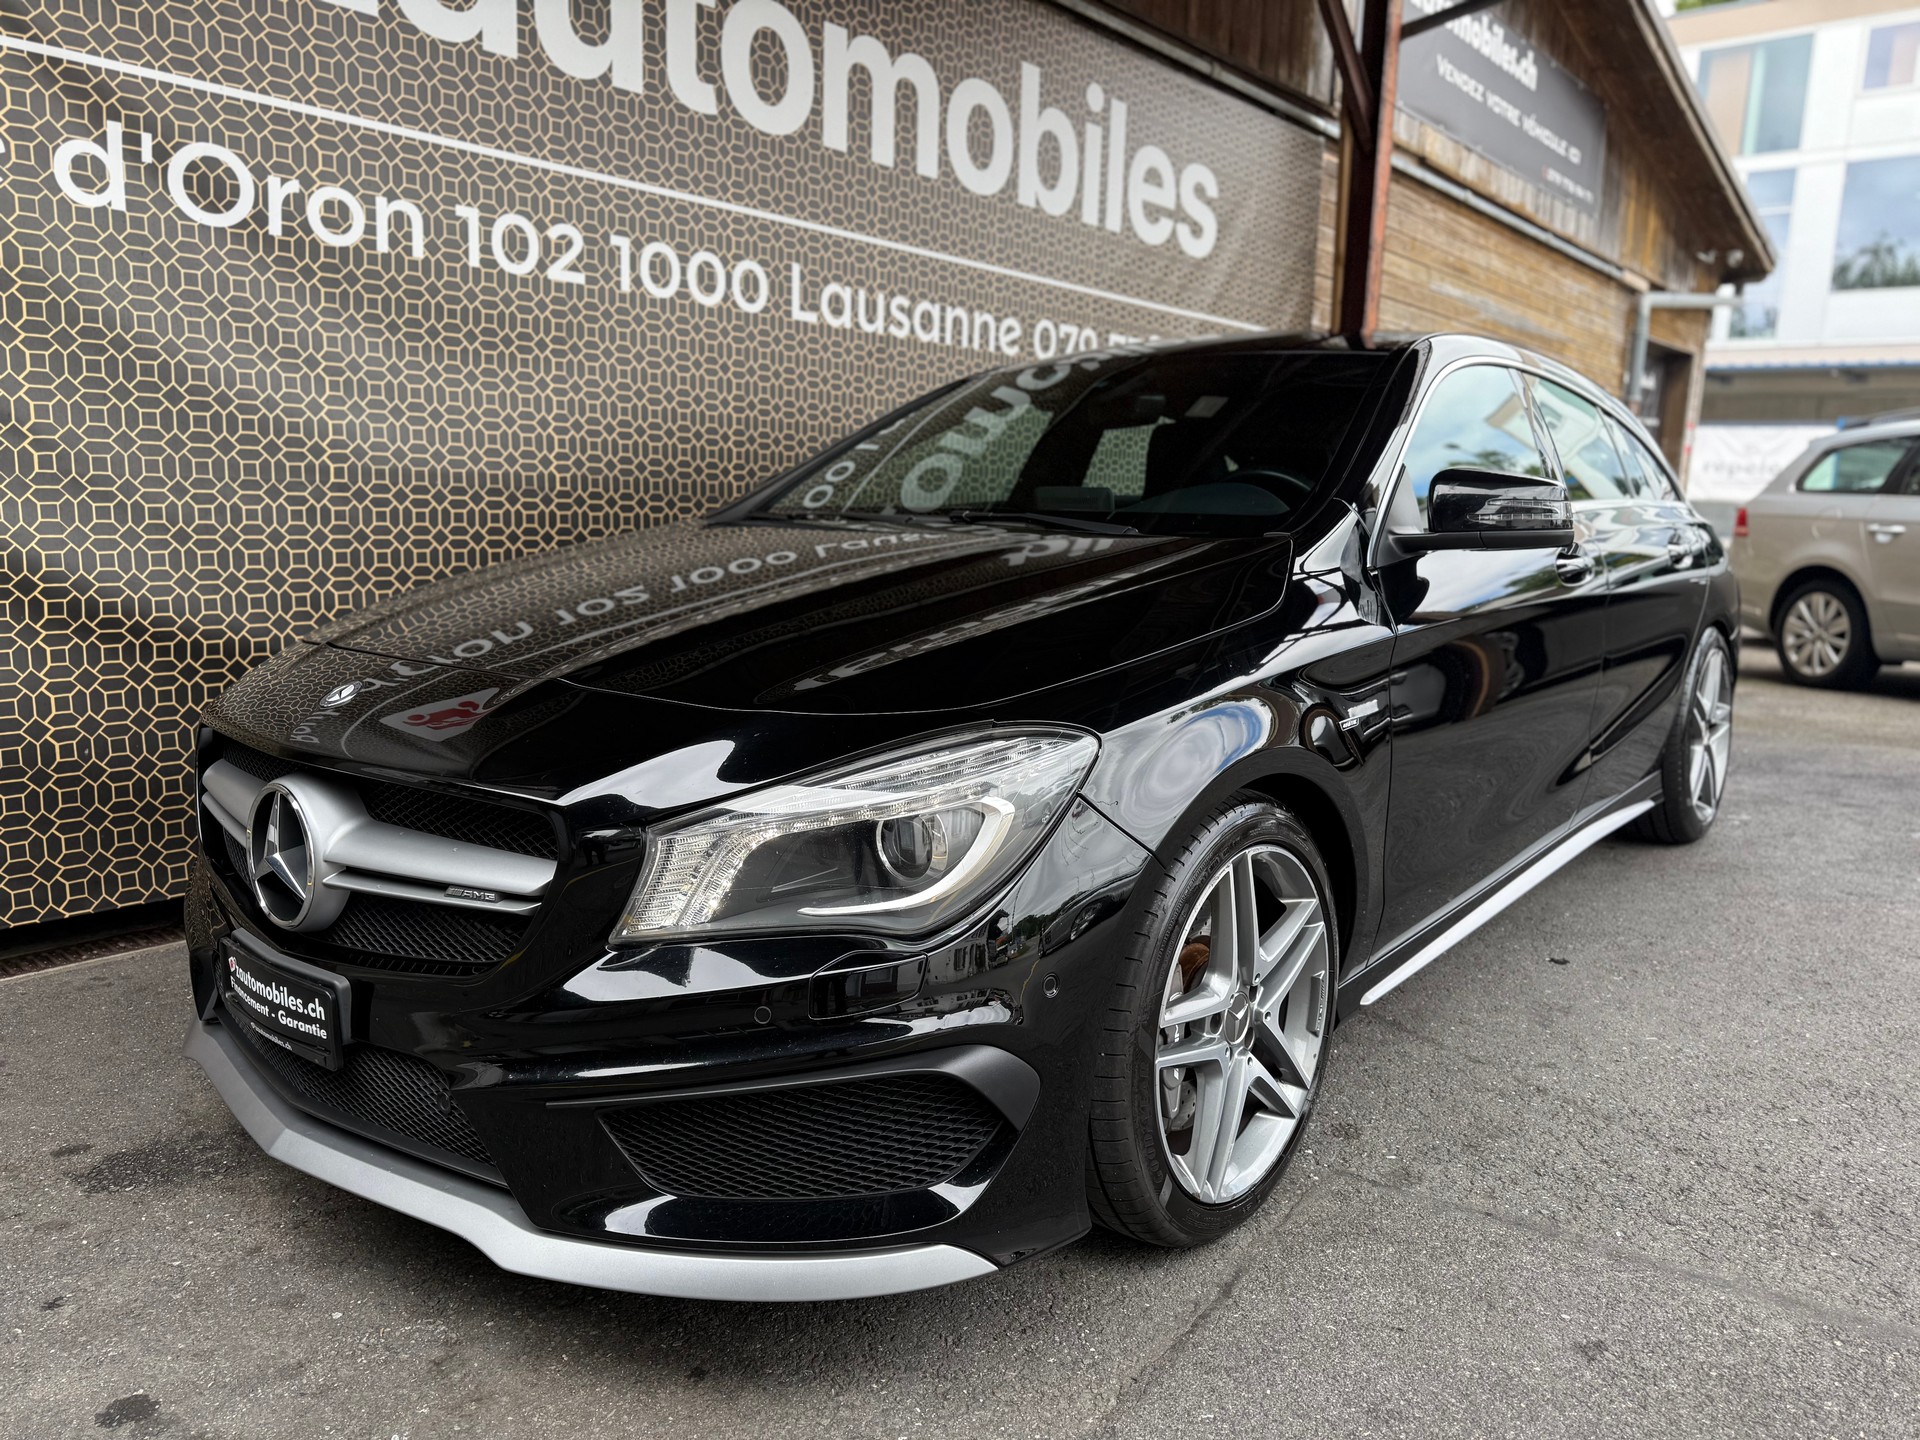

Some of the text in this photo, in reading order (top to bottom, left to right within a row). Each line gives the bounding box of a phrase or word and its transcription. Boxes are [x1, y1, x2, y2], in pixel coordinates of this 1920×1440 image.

[1436, 53, 1485, 102] VENDEZ
[1485, 90, 1522, 127] VOTRE
[53, 119, 425, 258] d'Oron
[455, 204, 586, 285] 102
[610, 234, 769, 314] 1000
[790, 262, 1022, 357] Lausanne
[462, 889, 496, 901] AMG
[230, 975, 270, 1017] Financement
[277, 1009, 328, 1039] Garantie
[235, 964, 326, 1021] zautomobiles.ch
